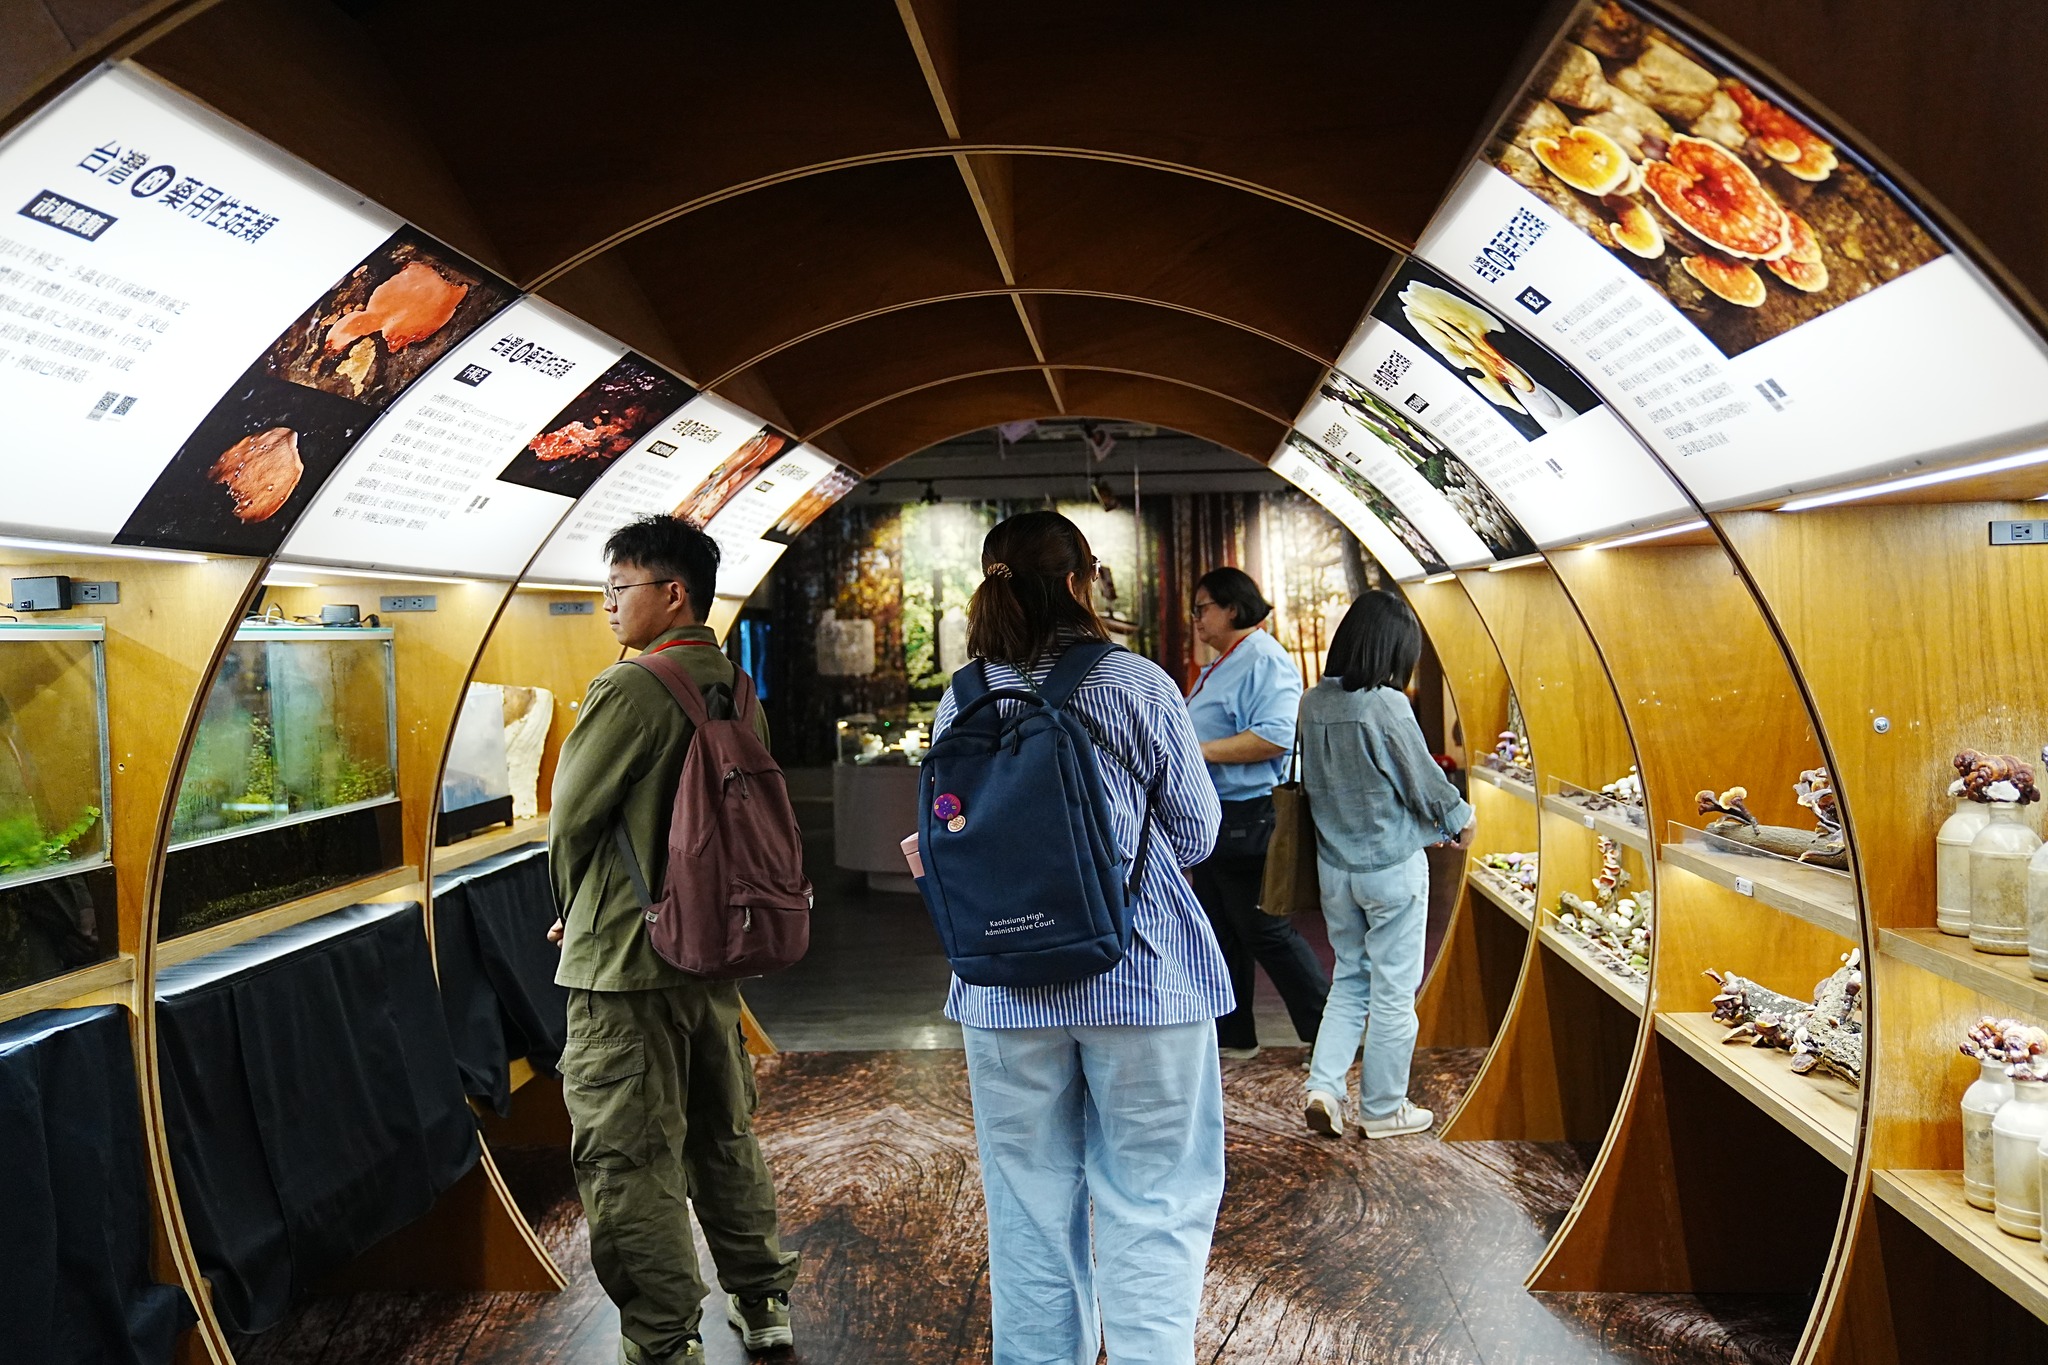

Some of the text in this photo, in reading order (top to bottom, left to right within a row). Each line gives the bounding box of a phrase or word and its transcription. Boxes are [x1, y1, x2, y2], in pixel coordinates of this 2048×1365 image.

[76, 140, 280, 244] 台灣的藥用性菇類
[984, 919, 1055, 936] Administrative Court
[989, 911, 1045, 927] Kaohsiung High
